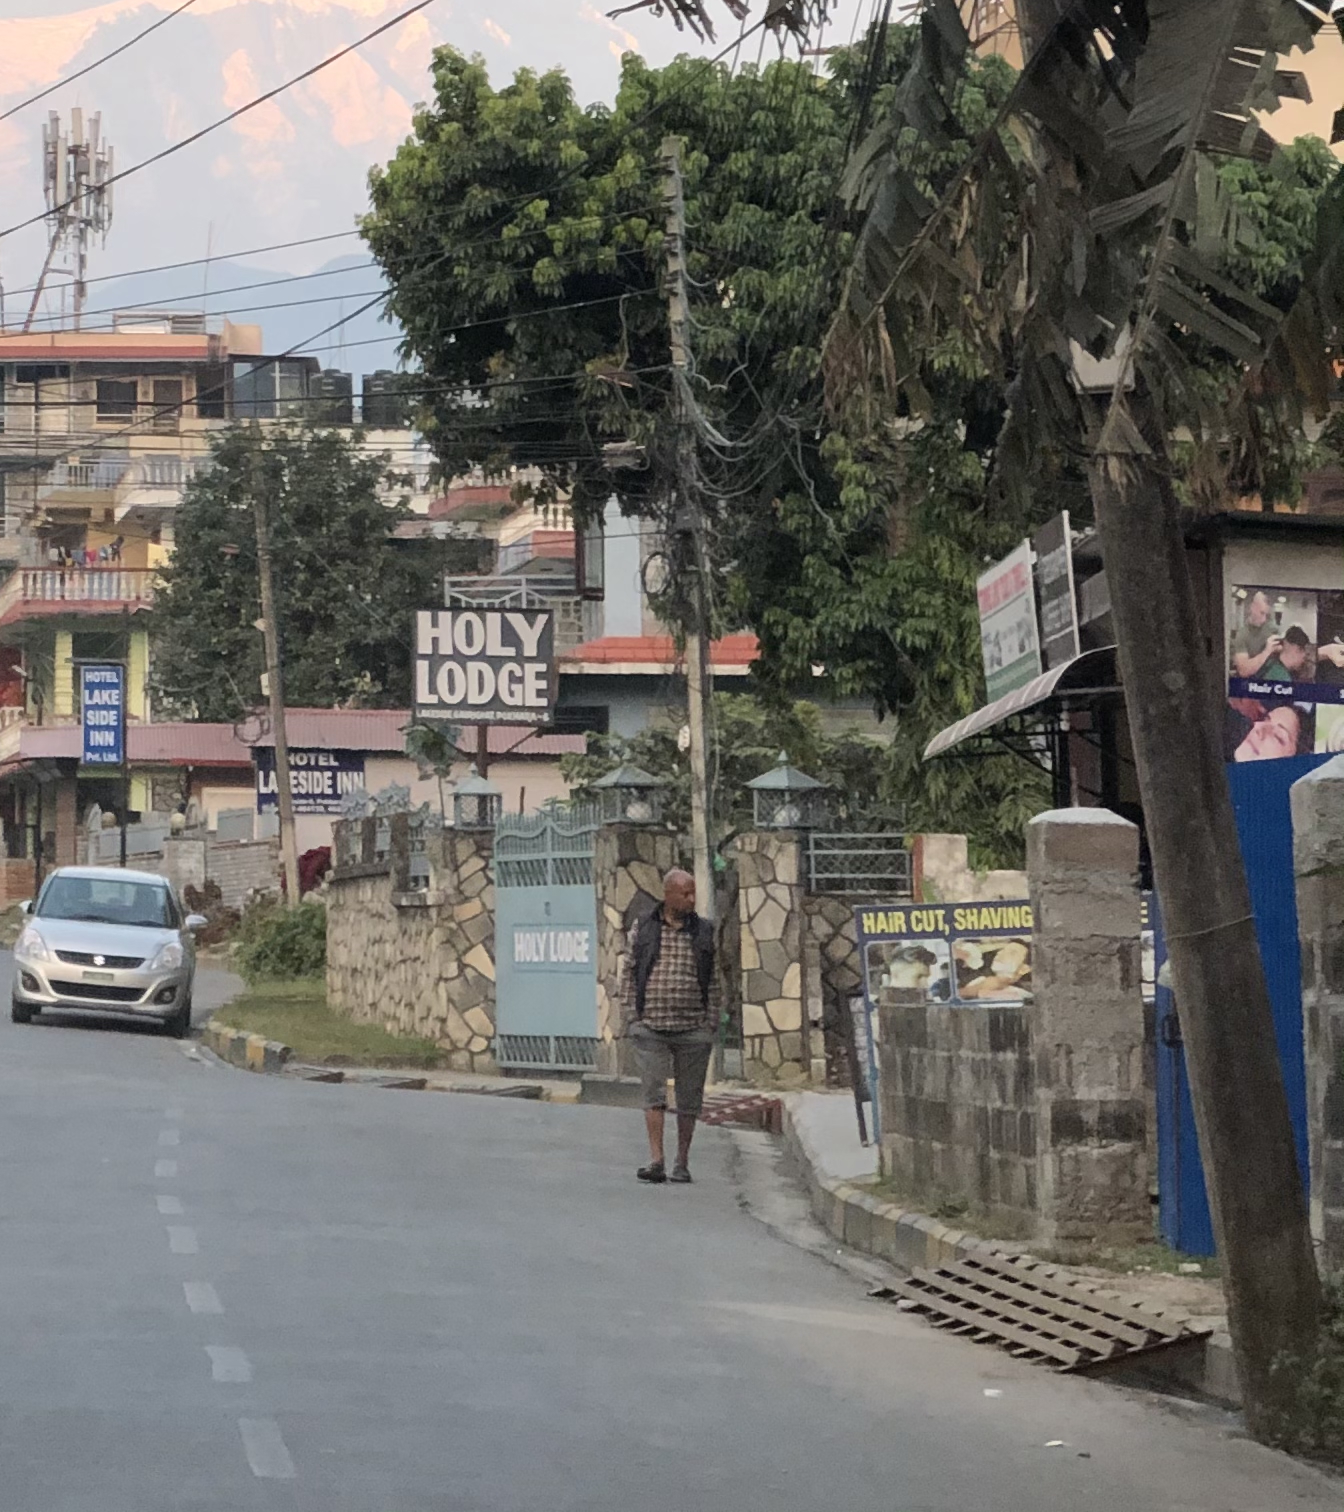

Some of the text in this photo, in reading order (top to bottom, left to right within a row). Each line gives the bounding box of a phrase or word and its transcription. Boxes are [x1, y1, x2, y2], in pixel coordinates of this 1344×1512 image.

[416, 610, 550, 657] HOLY
[85, 671, 119, 683] HOTEL
[415, 659, 549, 707] LODGE
[84, 689, 119, 705] LAKE
[1248, 682, 1272, 694] Hair
[86, 710, 118, 726] SIDE
[89, 730, 115, 747] INN
[258, 770, 365, 795] LAESIDE INN
[911, 909, 950, 936] CUT,
[954, 905, 1033, 931] SHAVING
[514, 931, 589, 963] HOLY LODGE
